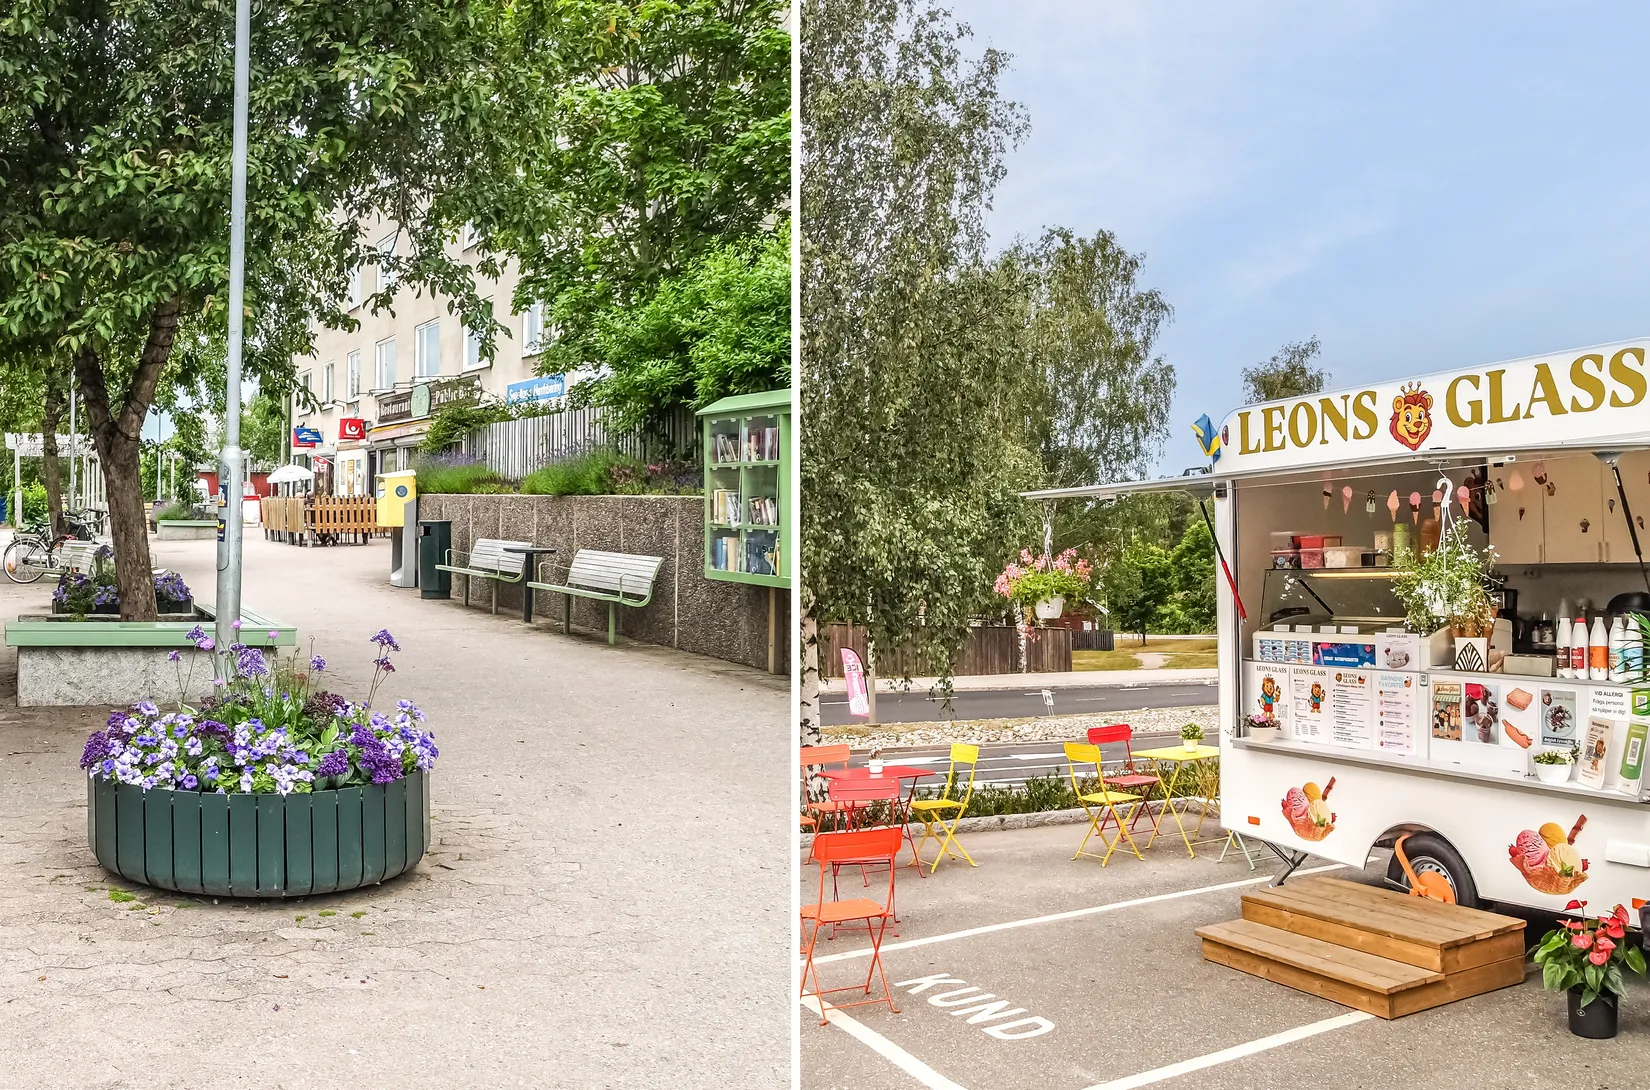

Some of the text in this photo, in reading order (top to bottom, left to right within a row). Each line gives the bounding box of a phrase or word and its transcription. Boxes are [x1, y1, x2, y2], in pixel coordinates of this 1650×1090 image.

[1238, 347, 1647, 455] LEONS GLASS
[1310, 669, 1327, 677] GLASS
[893, 973, 1055, 1040] KUND
